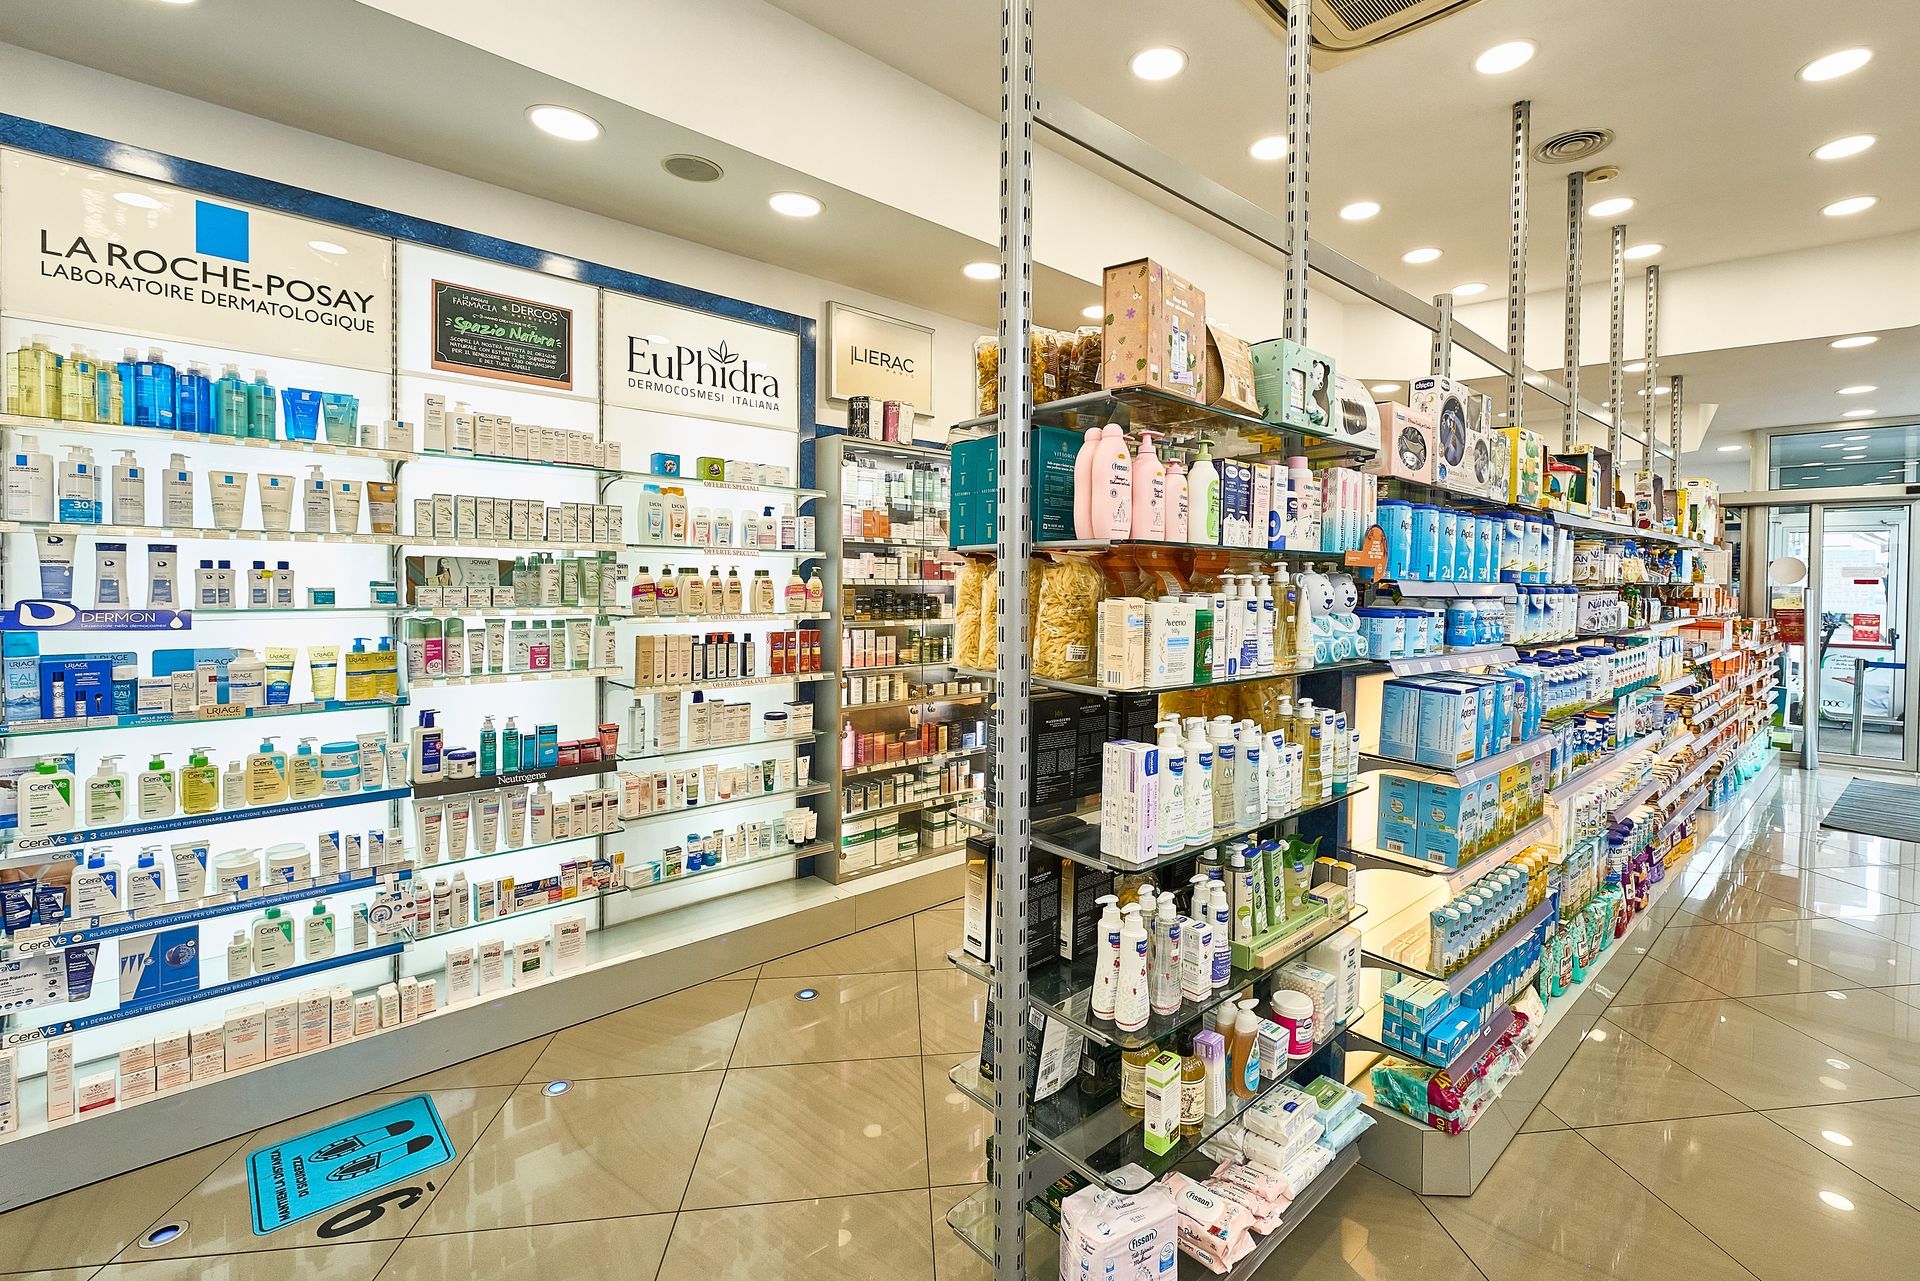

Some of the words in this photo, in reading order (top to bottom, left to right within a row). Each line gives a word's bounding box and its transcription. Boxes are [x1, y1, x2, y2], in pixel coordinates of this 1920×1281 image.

[40, 229, 98, 263] LA
[107, 242, 375, 314] ROCHE-POSAY
[40, 260, 194, 302] LABORATOIRE
[201, 290, 375, 334] DERMATOLOGIQUE
[452, 296, 498, 313] FARMACIA
[511, 303, 558, 321] DERCOS
[453, 316, 506, 337] Spazio
[509, 326, 555, 348] Natura
[449, 336, 472, 345] SCOPRI
[481, 341, 503, 350] NOSTRA
[449, 341, 477, 351] NATURALE
[491, 348, 518, 359] ESTRATTI
[851, 345, 914, 373] LIERAC
[627, 335, 780, 399] EuPhidra
[1415, 381, 1434, 389] chicco
[628, 377, 724, 403] DERMOCOSMESI
[731, 396, 780, 411] ITALIANA
[703, 481, 730, 489] OFFERTE
[731, 483, 760, 492] SPECIALI
[703, 548, 730, 556] OFFERTE
[81, 612, 156, 623] DERMON
[1164, 618, 1187, 627] Aveeno
[9, 660, 36, 668] URIAGE
[9, 672, 37, 682] EAU
[712, 680, 740, 688] OFFERTE
[173, 682, 194, 691] EAU
[206, 705, 241, 715] URIAGE
[1823, 699, 1845, 708] DOC
[1460, 706, 1476, 720] Aptamil
[497, 771, 548, 785] Neutrogena
[30, 782, 67, 792] CeraVe
[19, 835, 67, 849] CeraVe
[90, 832, 97, 840] 3
[100, 829, 132, 838] CERAMIDI
[132, 823, 168, 833] ESSENZIALI
[183, 816, 223, 826] RIPRISTINARE
[232, 811, 261, 820] FUNZIONE
[262, 807, 289, 816] BARRIERA
[290, 804, 306, 812] DELLA
[307, 802, 325, 810] PELLE
[52, 851, 83, 860] CeraVe
[175, 849, 206, 861] CeraVe
[78, 873, 114, 885] CeraVe
[132, 872, 160, 882] CeraVe
[19, 935, 67, 952] CeraVe
[89, 928, 120, 938] RILASCIO
[120, 921, 153, 933] CONTINUO
[153, 918, 171, 927] DEGLI
[171, 914, 192, 924] ATTIVI
[282, 894, 299, 902] TUTTO
[260, 921, 289, 935] CeraVe
[309, 917, 332, 928] CeraVe
[561, 926, 580, 936] sebamed
[70, 950, 95, 959] CeraVe
[8, 1025, 57, 1044] CeraVe
[90, 1007, 143, 1025] DERMATOLOGIST
[144, 996, 191, 1012] RECOMMENDED
[193, 986, 231, 1000] MOISTURIZER
[232, 980, 252, 991] BRAND
[260, 976, 271, 984] THE
[270, 1148, 285, 1180] DISTANZA
[292, 1154, 309, 1189] SICUREZZA
[298, 1188, 310, 1198] DI
[1188, 1191, 1211, 1207] Fissan
[275, 1186, 291, 1222] MANTIENI
[1131, 1231, 1155, 1250] Fissan
